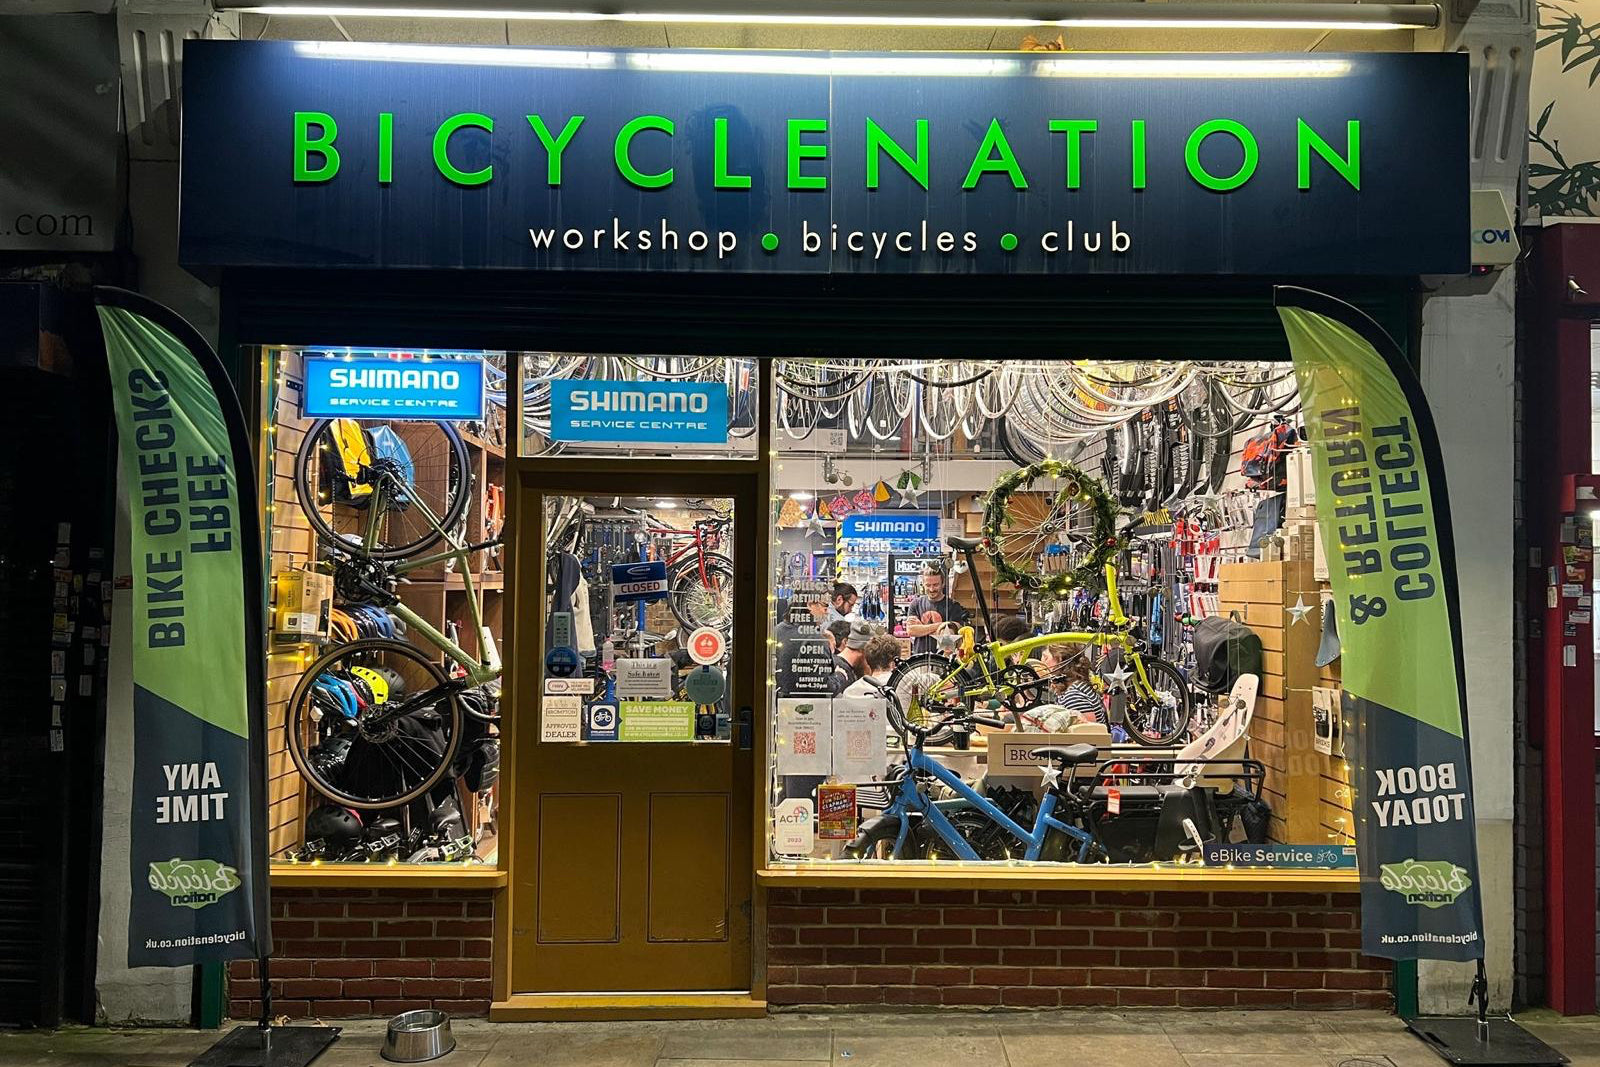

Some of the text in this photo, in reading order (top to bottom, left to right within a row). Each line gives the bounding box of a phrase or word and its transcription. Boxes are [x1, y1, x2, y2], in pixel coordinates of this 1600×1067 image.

[293, 111, 1361, 192] BICYCLENATION
[0, 213, 94, 236] .com
[529, 218, 1132, 260] workshop bicycles club
[330, 368, 459, 391] SHIMANO
[330, 398, 458, 408] SERVICE CENTRE
[570, 390, 708, 413] SHIMANO
[570, 420, 707, 430] SERVICE CENTRE
[854, 521, 925, 533] SHIMANO
[620, 581, 660, 593] CLOSED
[790, 613, 811, 623] FREE
[800, 645, 824, 655] OPEN
[791, 664, 832, 675] 8am-7pm
[626, 705, 688, 713] SAVE MONEY
[780, 815, 800, 823] ACT
[1210, 849, 1313, 862] eBike Service
